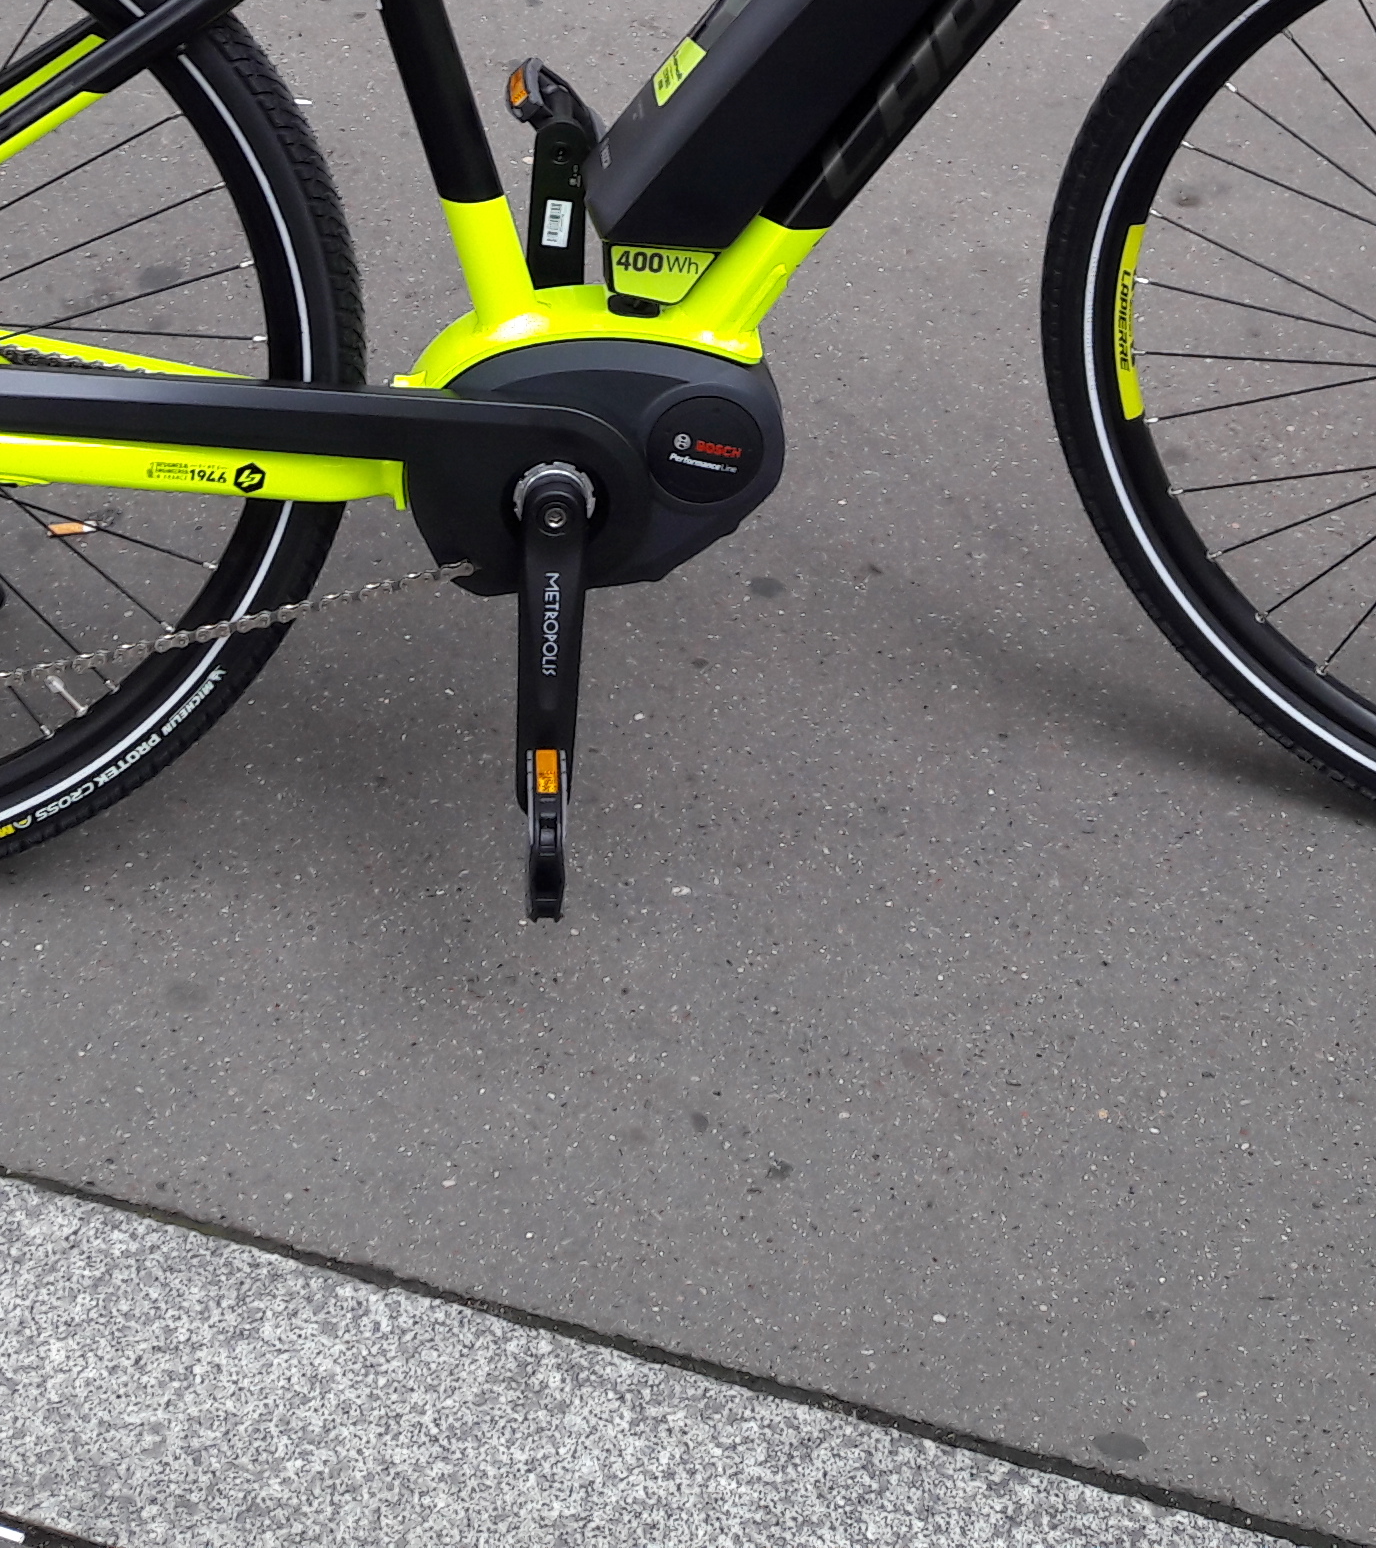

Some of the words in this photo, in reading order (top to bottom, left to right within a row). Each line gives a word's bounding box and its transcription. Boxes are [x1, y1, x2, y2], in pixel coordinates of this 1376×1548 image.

[696, 440, 742, 458] BOSCH
[190, 469, 227, 483] 1946
[542, 572, 560, 677] METROPOLIS
[161, 680, 215, 736] MICHELIN
[96, 733, 162, 787] PROTEK
[35, 784, 95, 822] CROSS
